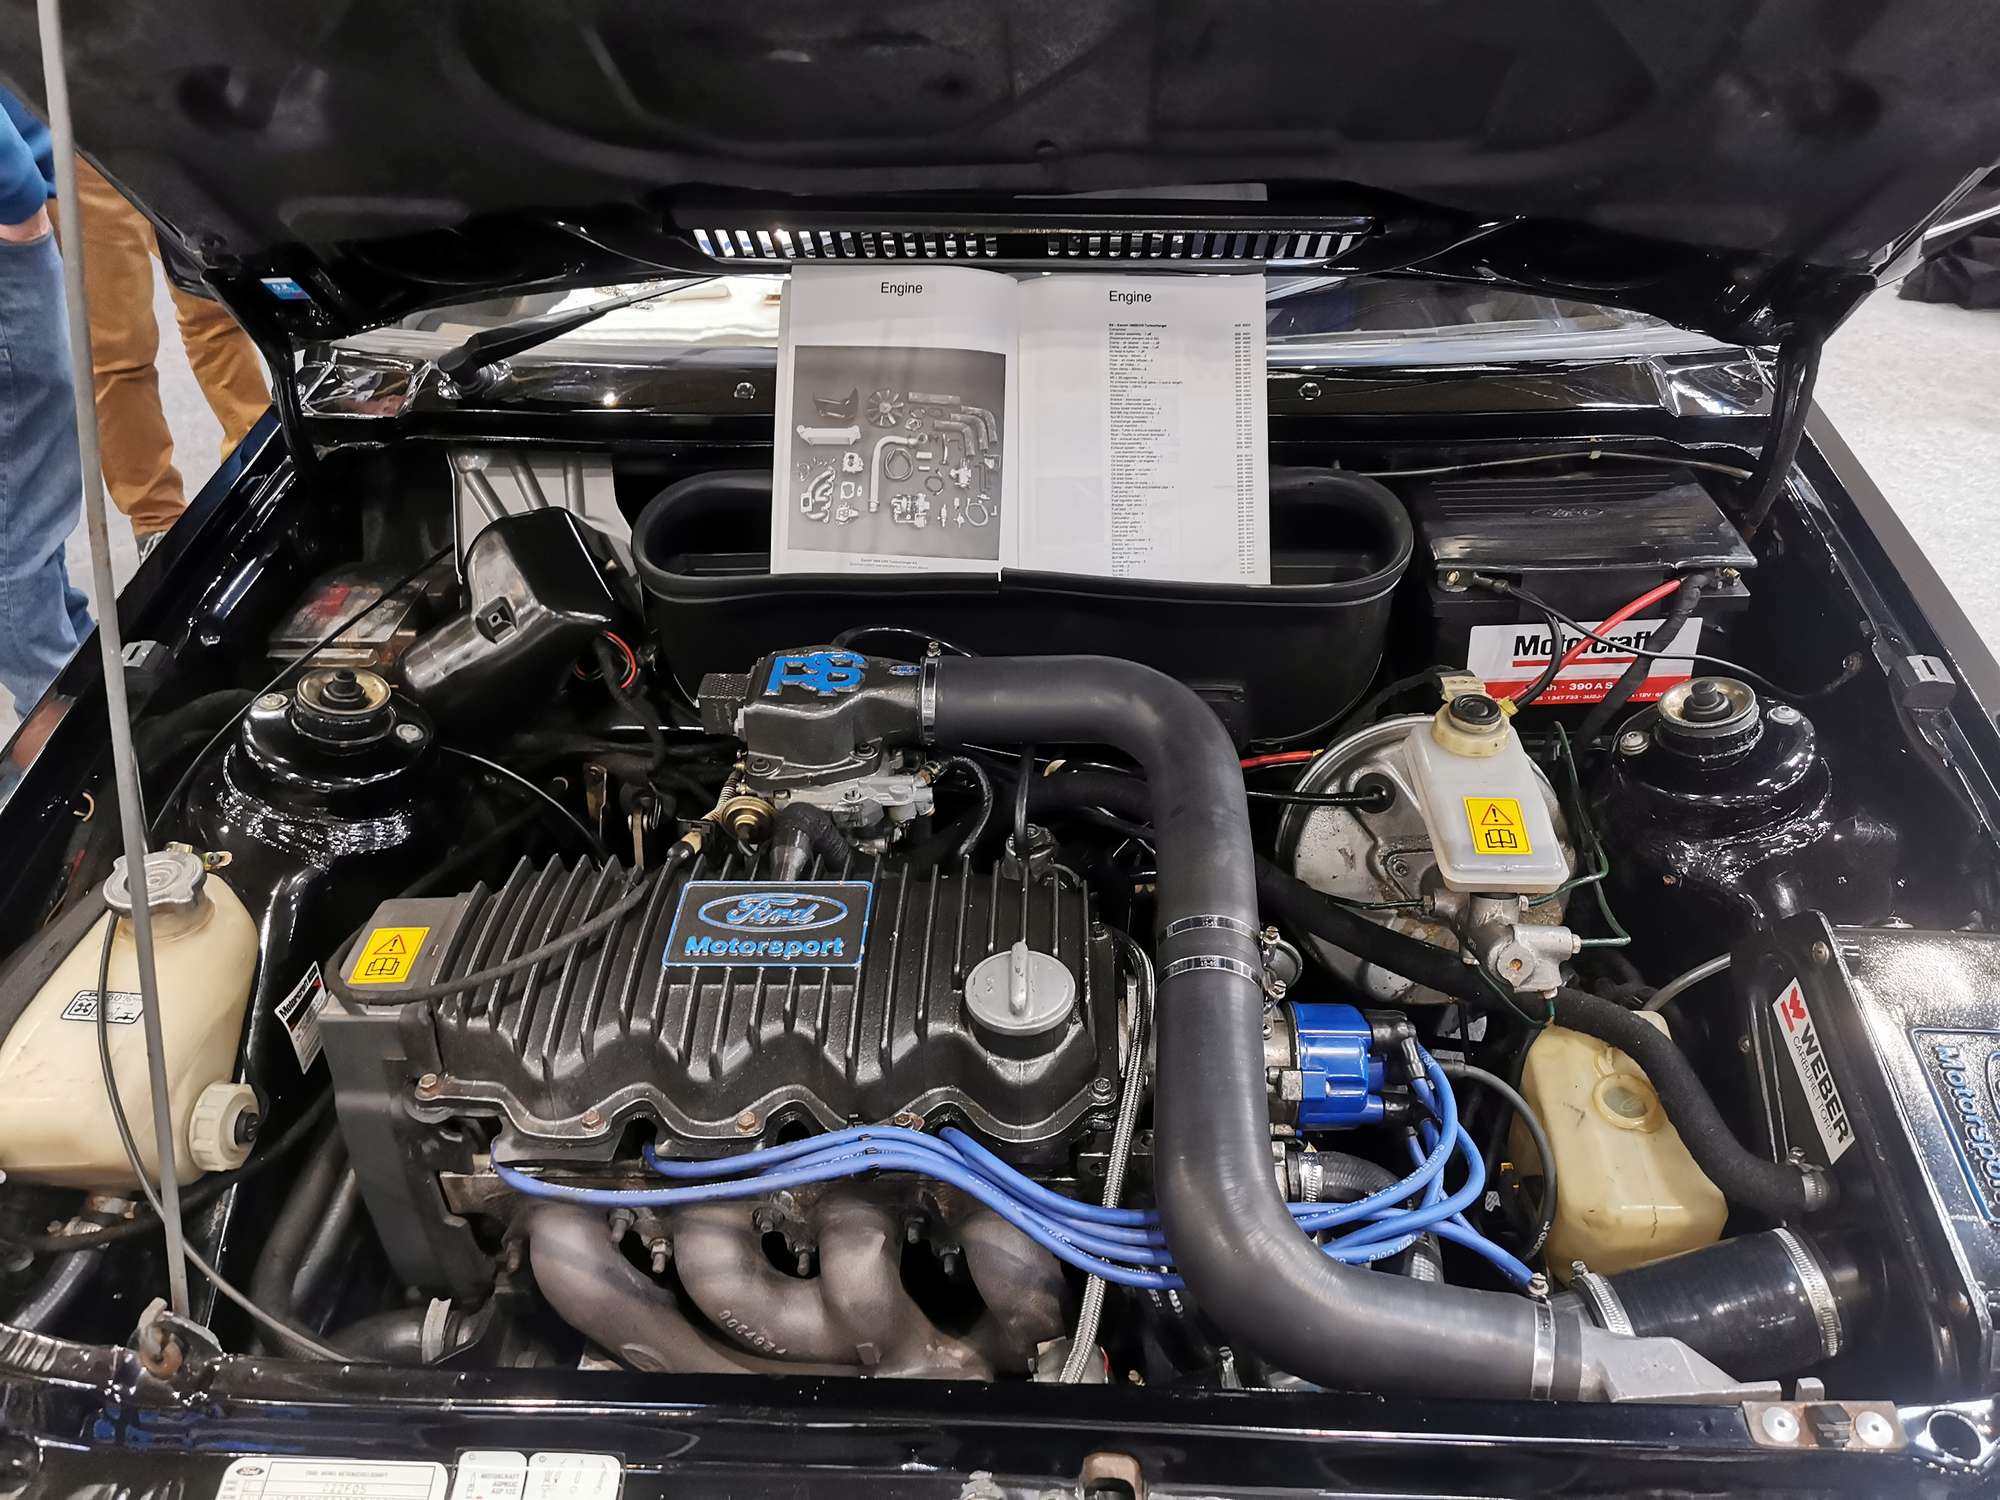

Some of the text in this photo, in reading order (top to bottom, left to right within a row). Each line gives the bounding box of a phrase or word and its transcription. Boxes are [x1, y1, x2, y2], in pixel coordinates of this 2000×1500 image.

[880, 281, 923, 296] Engine
[1109, 290, 1152, 305] Engine
[763, 651, 869, 696] RS
[726, 897, 820, 924] Ford
[684, 935, 845, 960] Motorsport
[1793, 1035, 1833, 1139] CARBURETTORS
[1800, 1023, 1849, 1144] WEBER
[1933, 1044, 2000, 1208] Motorspo
